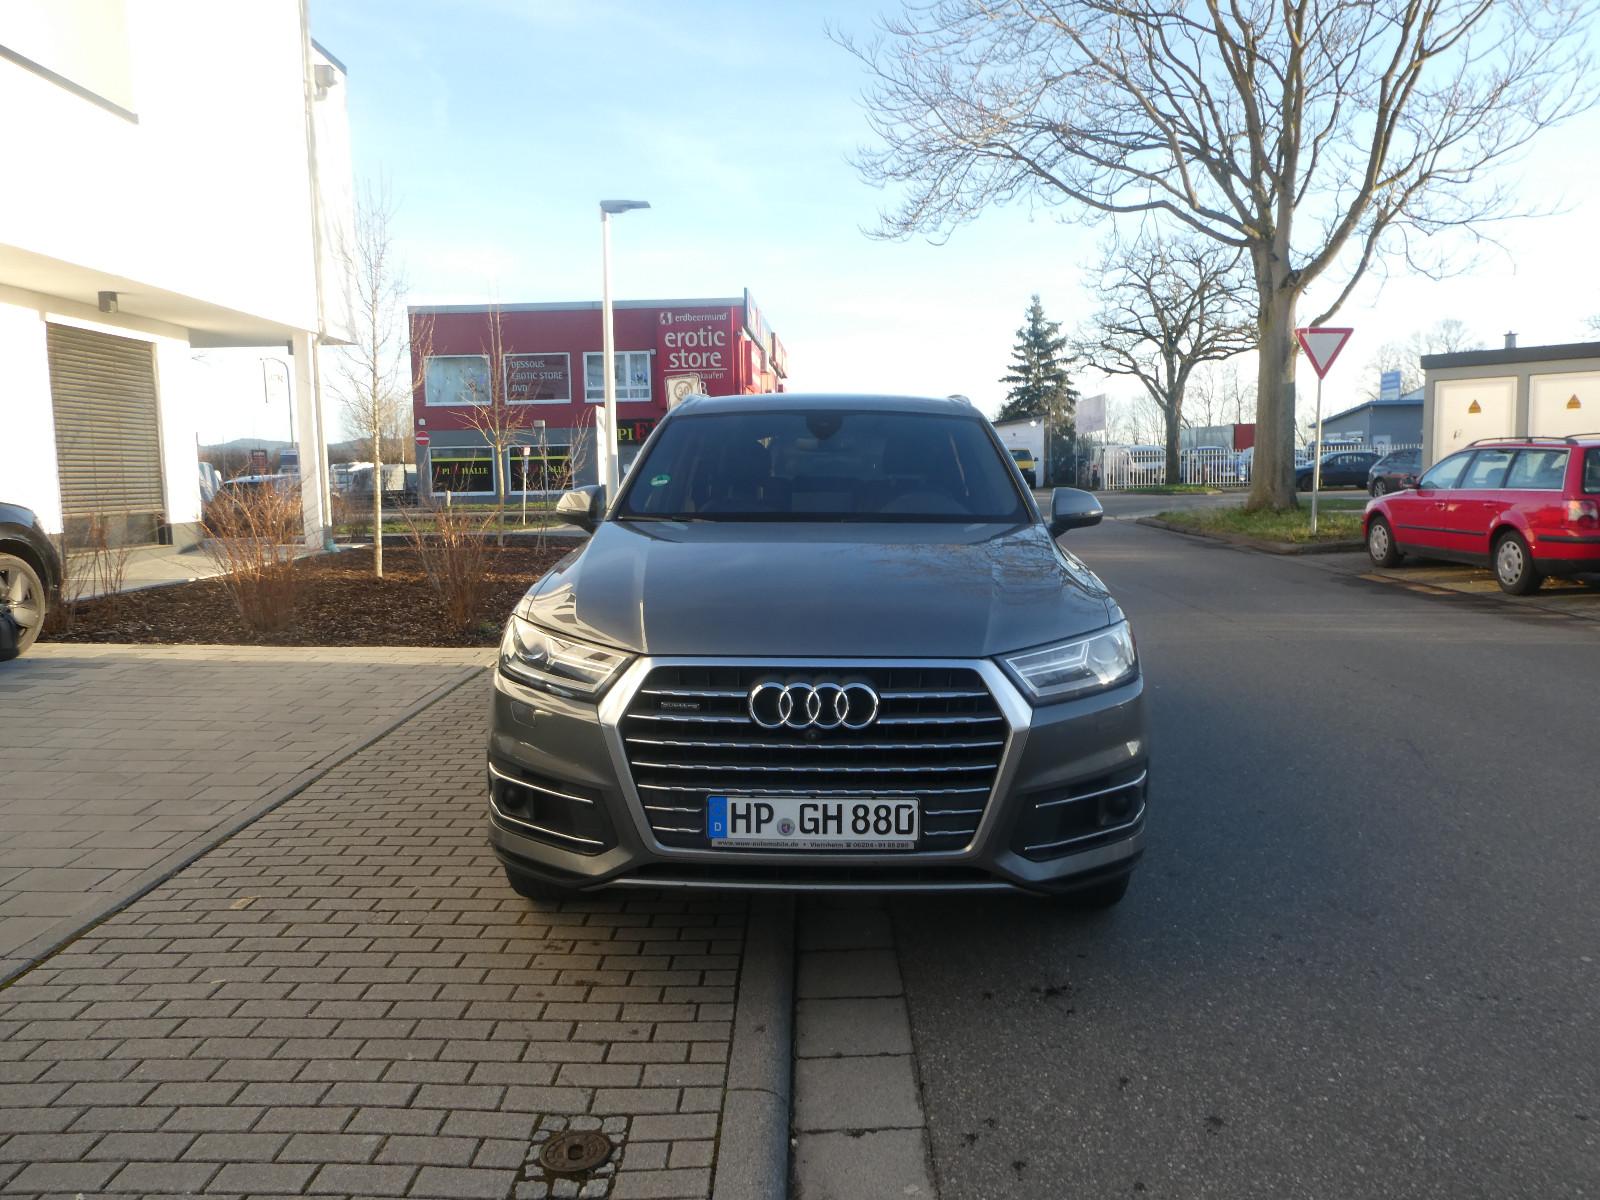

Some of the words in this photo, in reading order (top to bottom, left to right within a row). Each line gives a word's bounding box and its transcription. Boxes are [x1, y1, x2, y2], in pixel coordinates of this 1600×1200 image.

[664, 326, 726, 348] erotic
[511, 360, 545, 368] DESSOUS
[669, 349, 722, 368] store
[511, 371, 538, 380] EROTIC
[539, 371, 563, 380] STORE
[511, 384, 528, 392] DVD
[731, 802, 774, 834] HP
[799, 803, 842, 835] GH
[851, 804, 915, 835] 880
[714, 821, 722, 832] D
